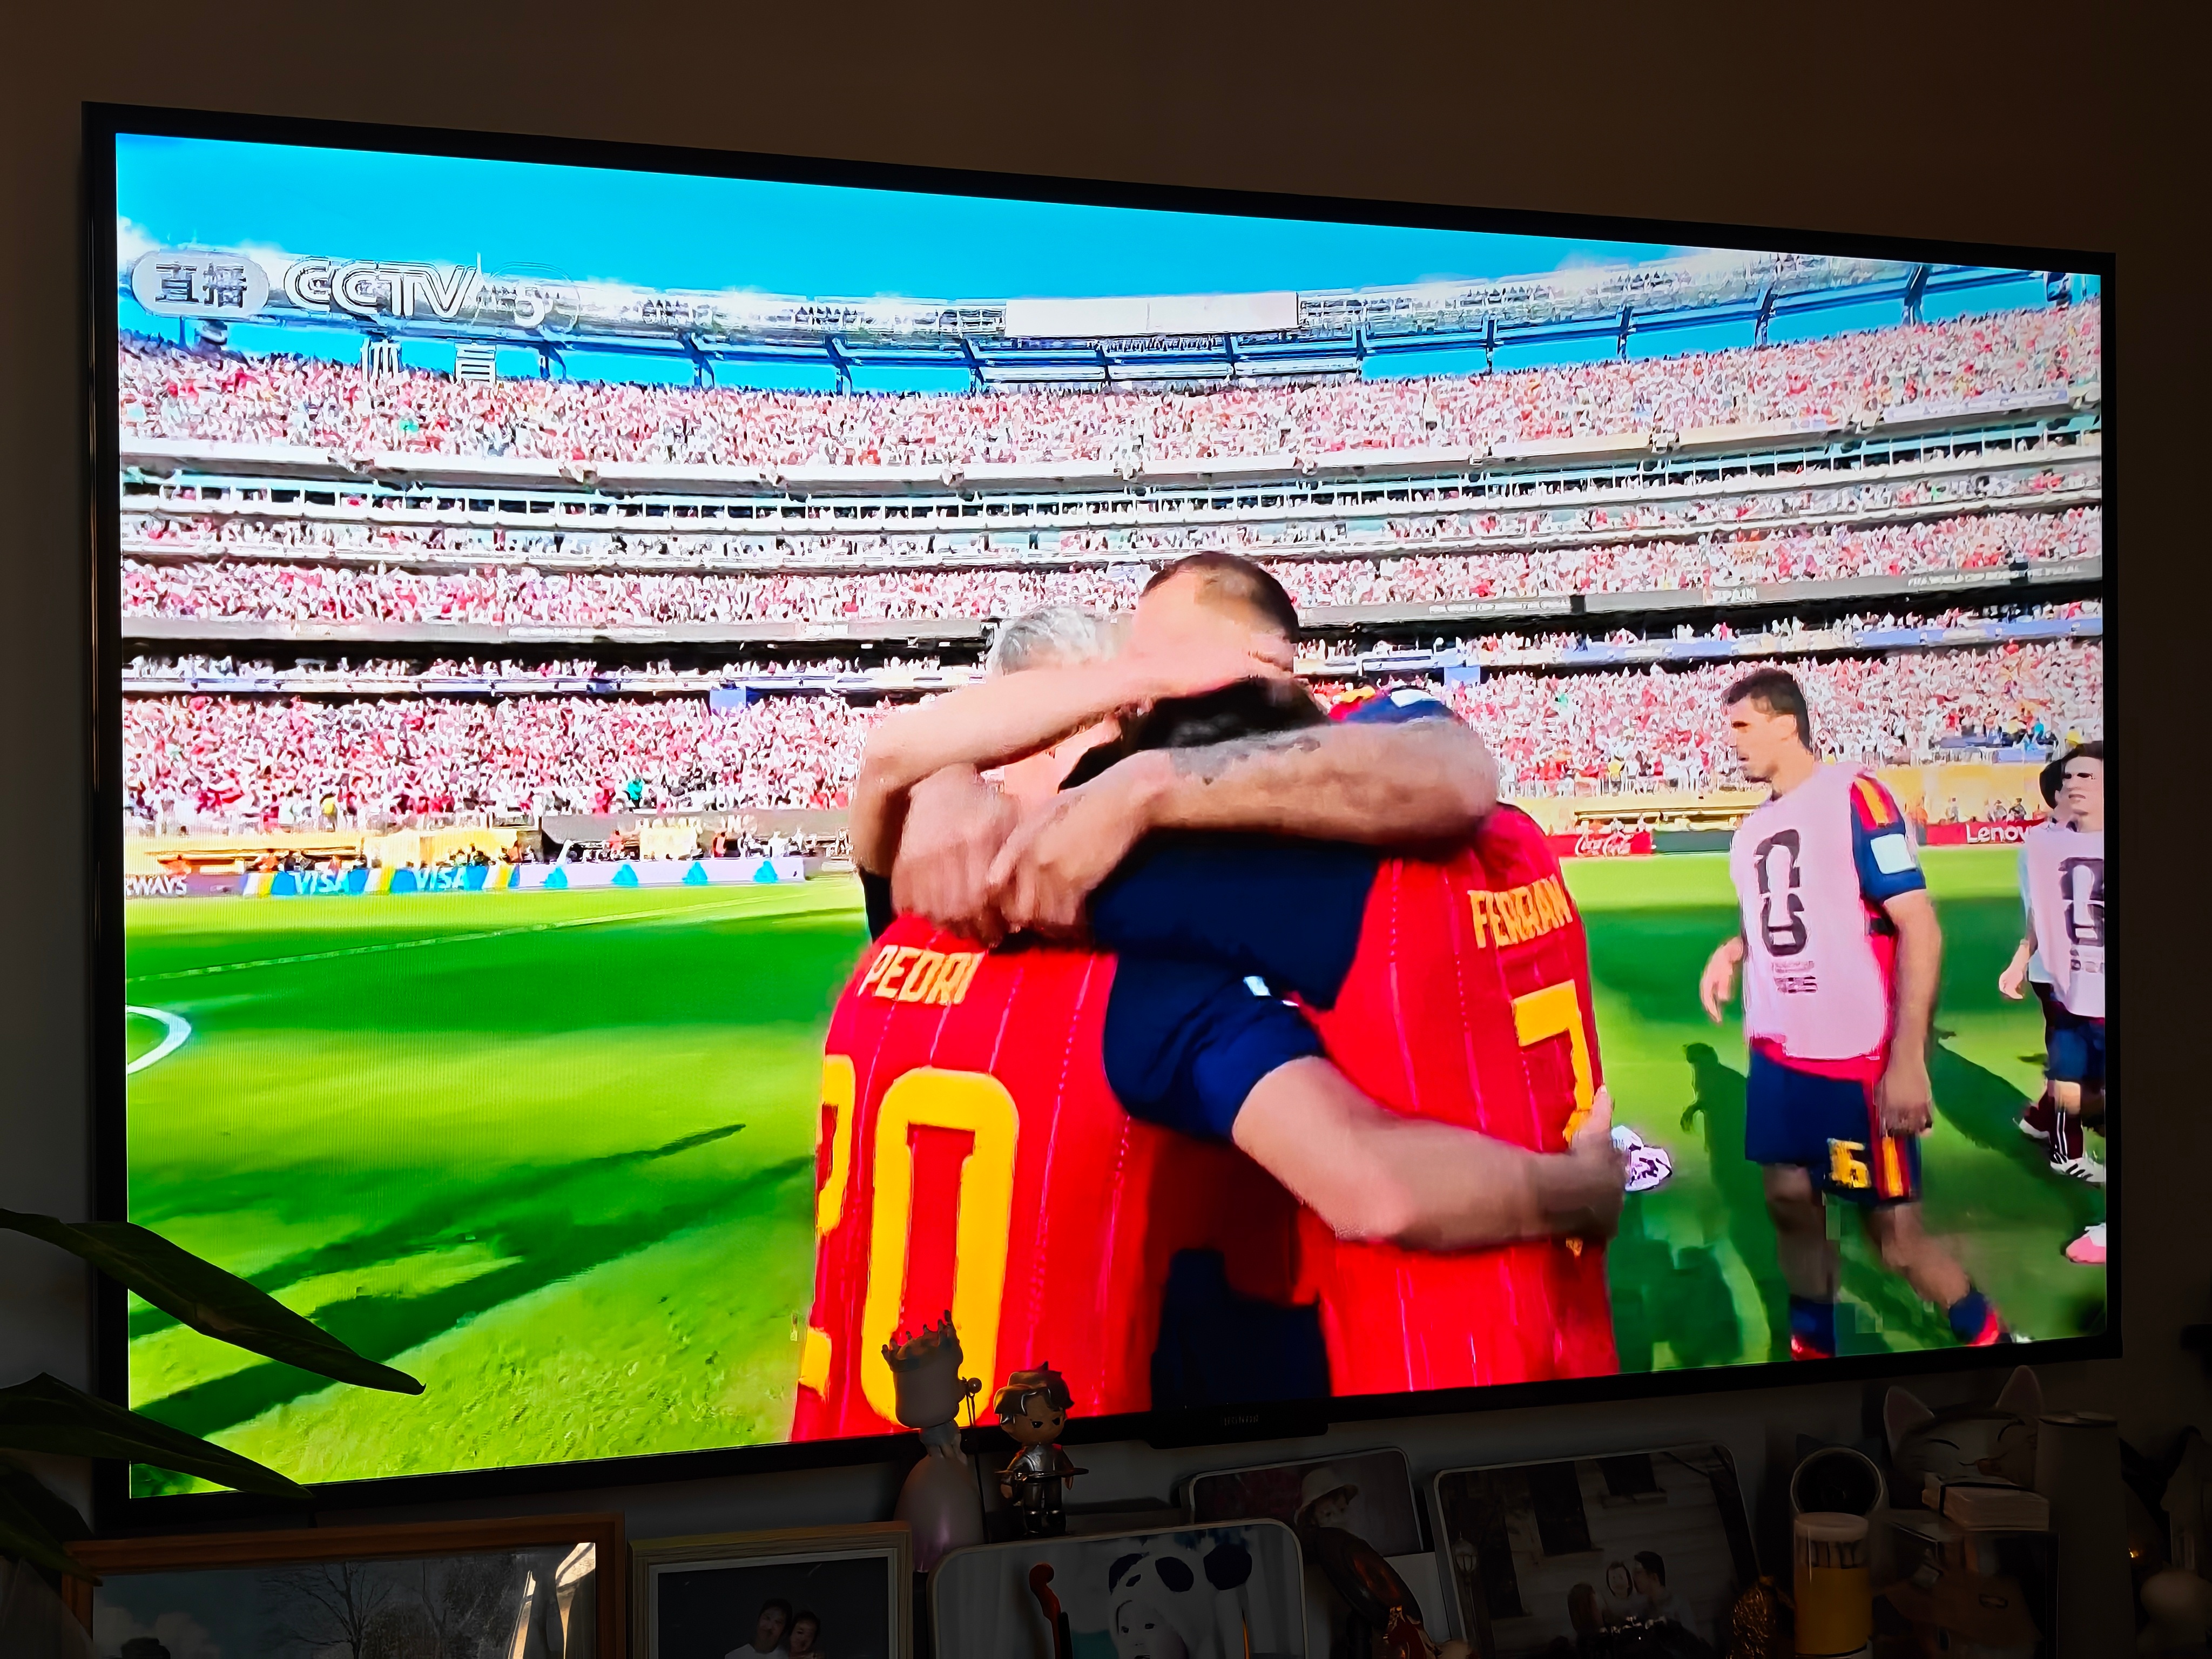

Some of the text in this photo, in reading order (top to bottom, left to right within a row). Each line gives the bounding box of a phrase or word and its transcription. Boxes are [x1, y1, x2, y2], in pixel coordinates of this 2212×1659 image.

[155, 261, 248, 308] 直播
[292, 865, 349, 894] VISA
[413, 864, 469, 892] VISA
[857, 944, 986, 1006] PEDRI
